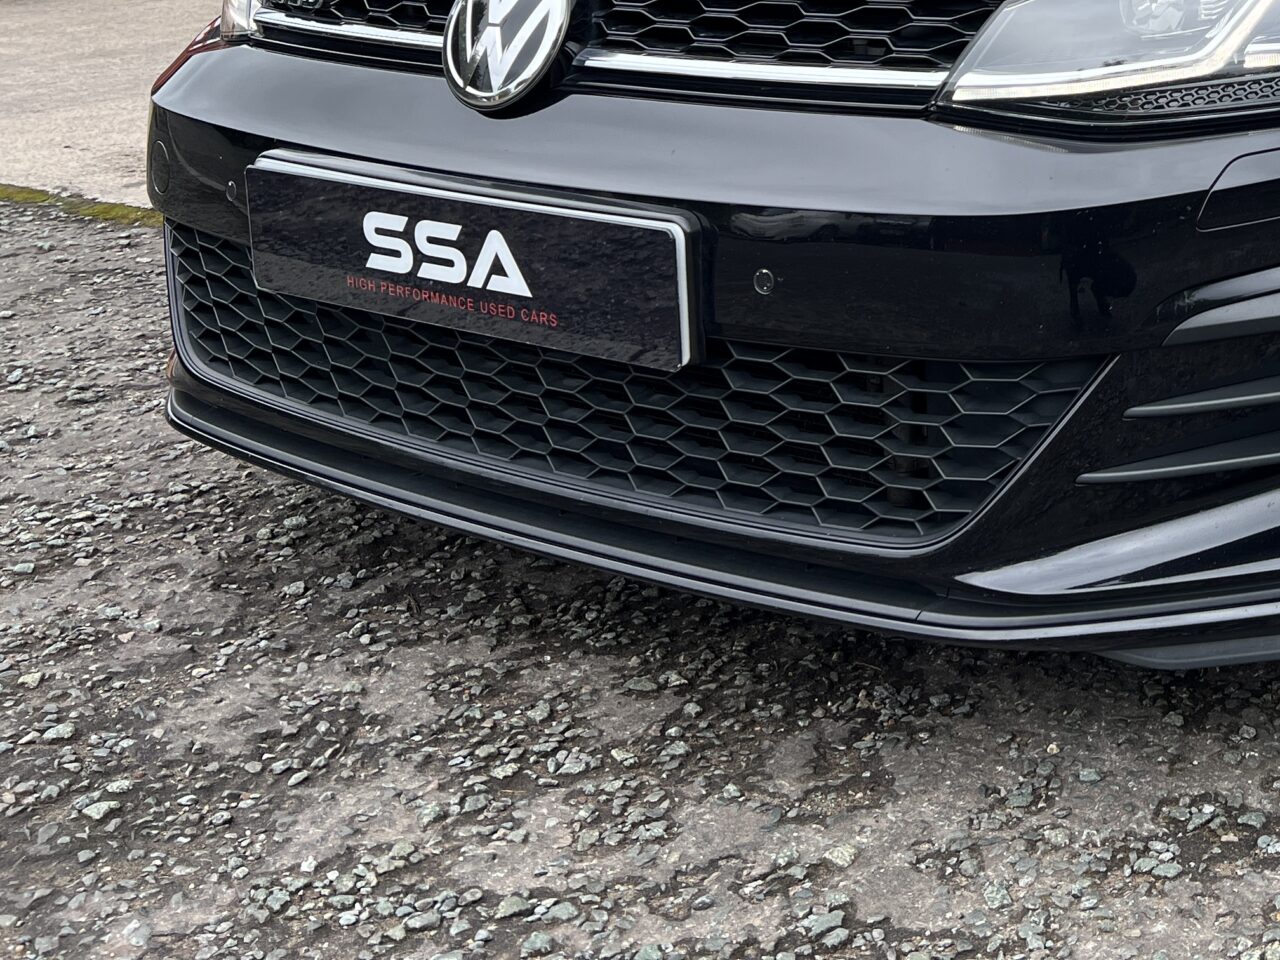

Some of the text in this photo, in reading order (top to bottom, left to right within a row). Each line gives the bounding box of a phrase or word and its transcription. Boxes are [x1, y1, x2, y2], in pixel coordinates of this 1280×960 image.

[362, 210, 533, 299] SSA
[346, 275, 559, 328] HIGH PERFORMANCE USED CARS
